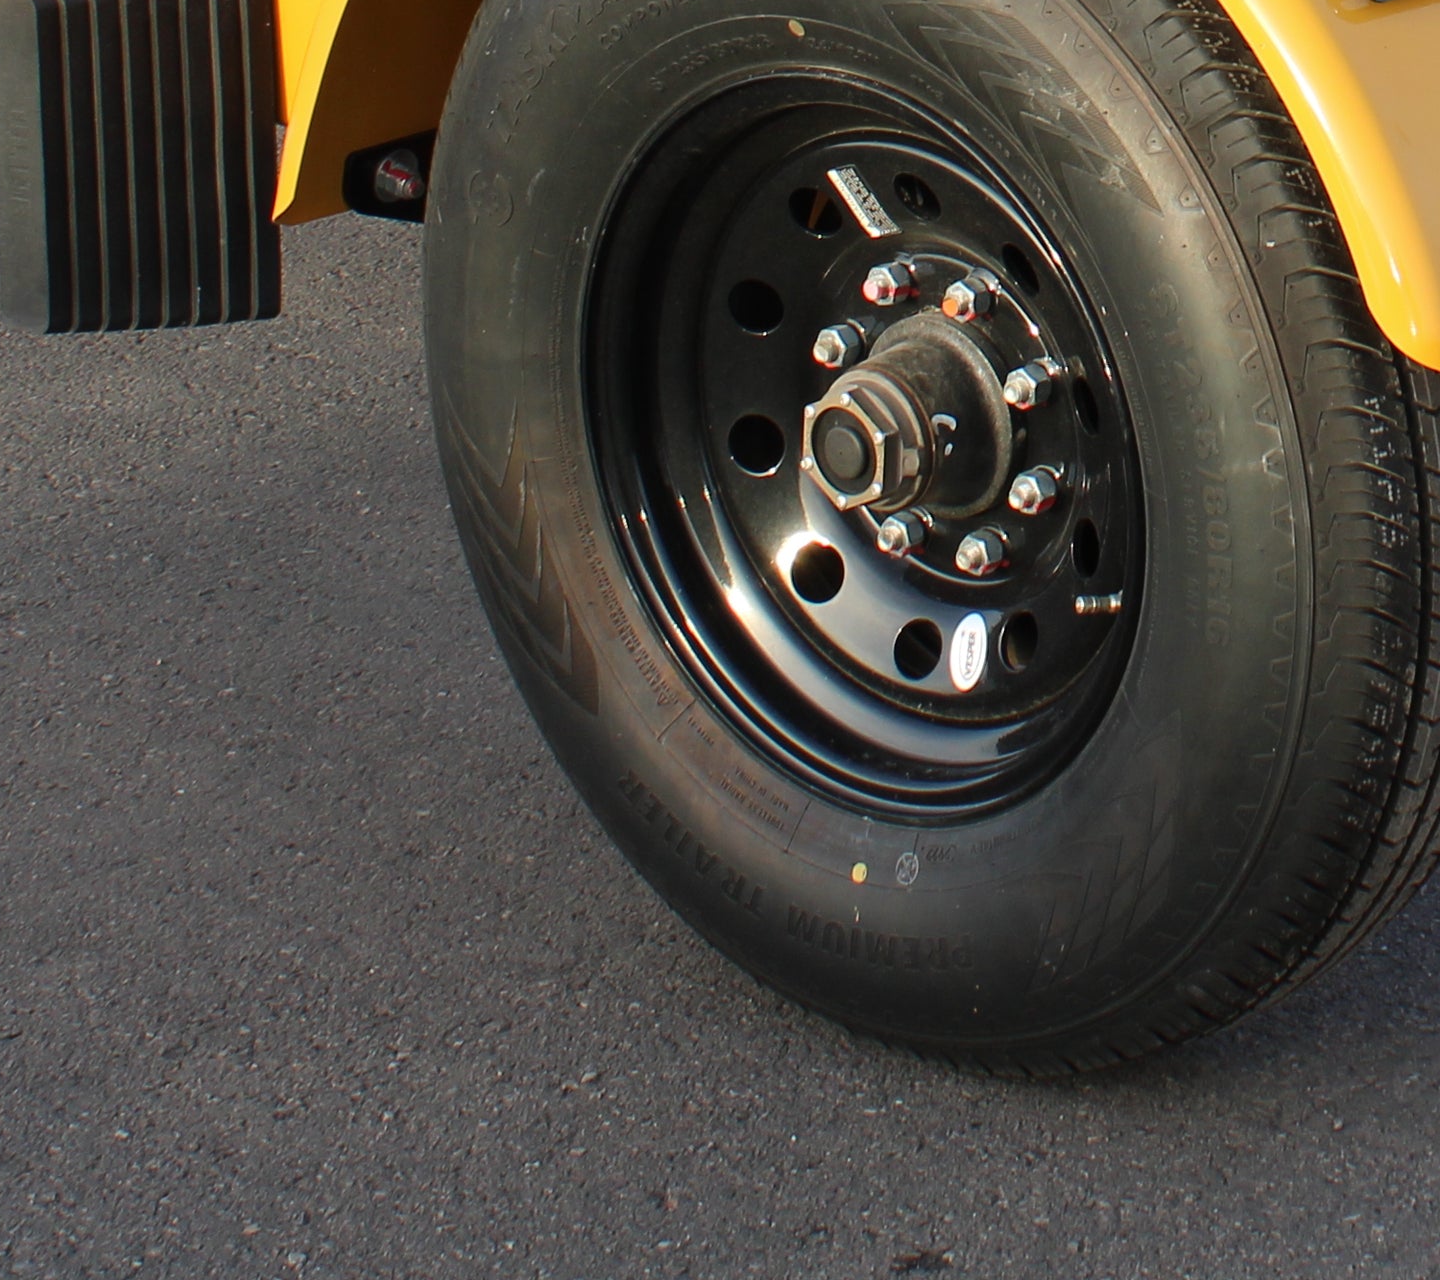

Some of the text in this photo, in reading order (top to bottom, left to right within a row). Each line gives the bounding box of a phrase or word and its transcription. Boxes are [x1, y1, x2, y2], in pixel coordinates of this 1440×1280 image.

[964, 631, 976, 676] VESPER
[616, 768, 975, 970] PREMIUM TRAILER
